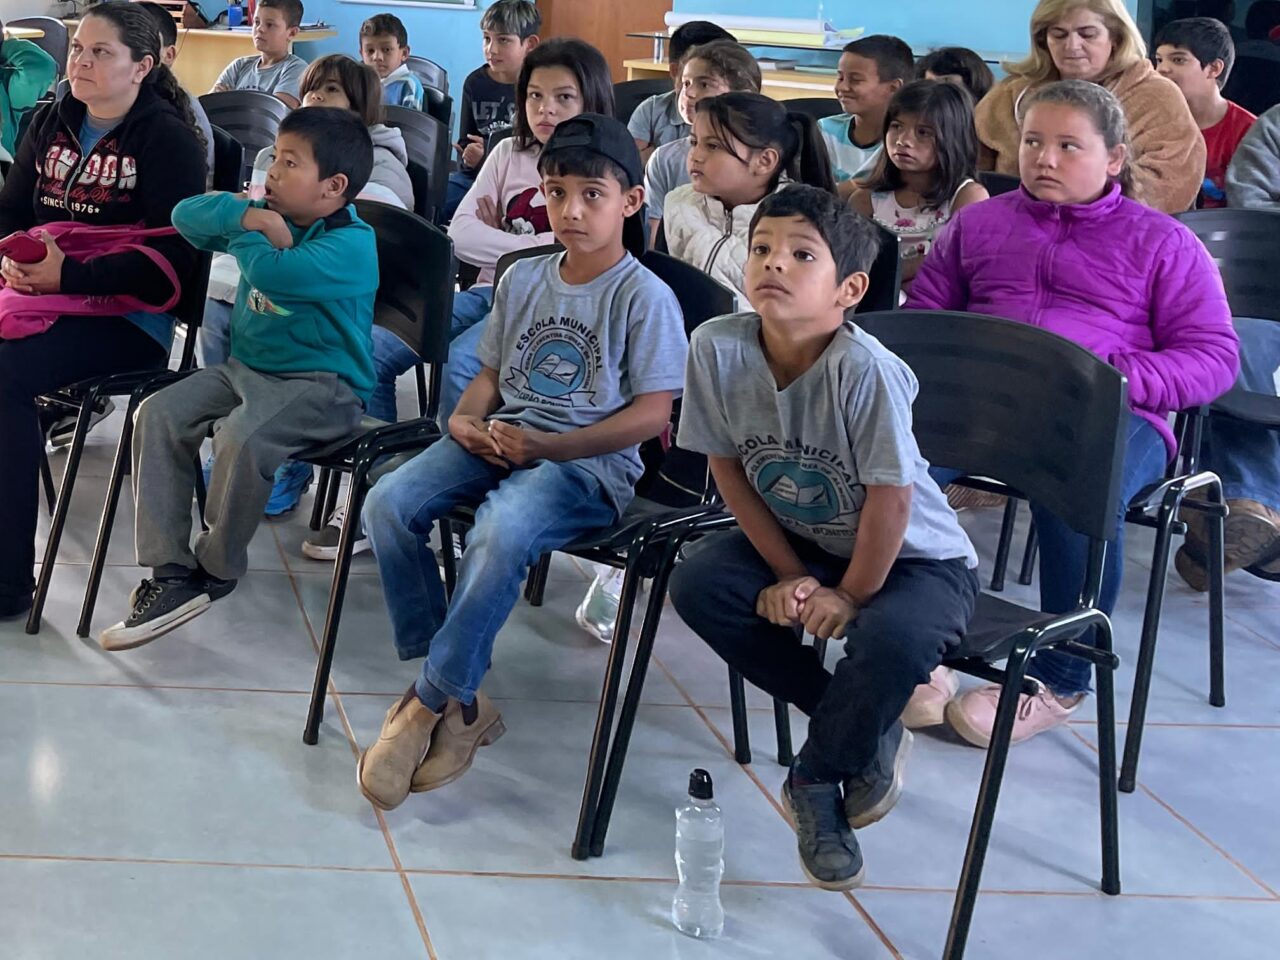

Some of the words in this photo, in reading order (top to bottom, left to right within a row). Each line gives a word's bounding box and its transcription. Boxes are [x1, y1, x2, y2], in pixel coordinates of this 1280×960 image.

[42, 196, 65, 209] SINCE
[71, 202, 94, 214] 1976
[515, 316, 556, 352] ESCOLA
[559, 316, 604, 374] MUNICIPAL
